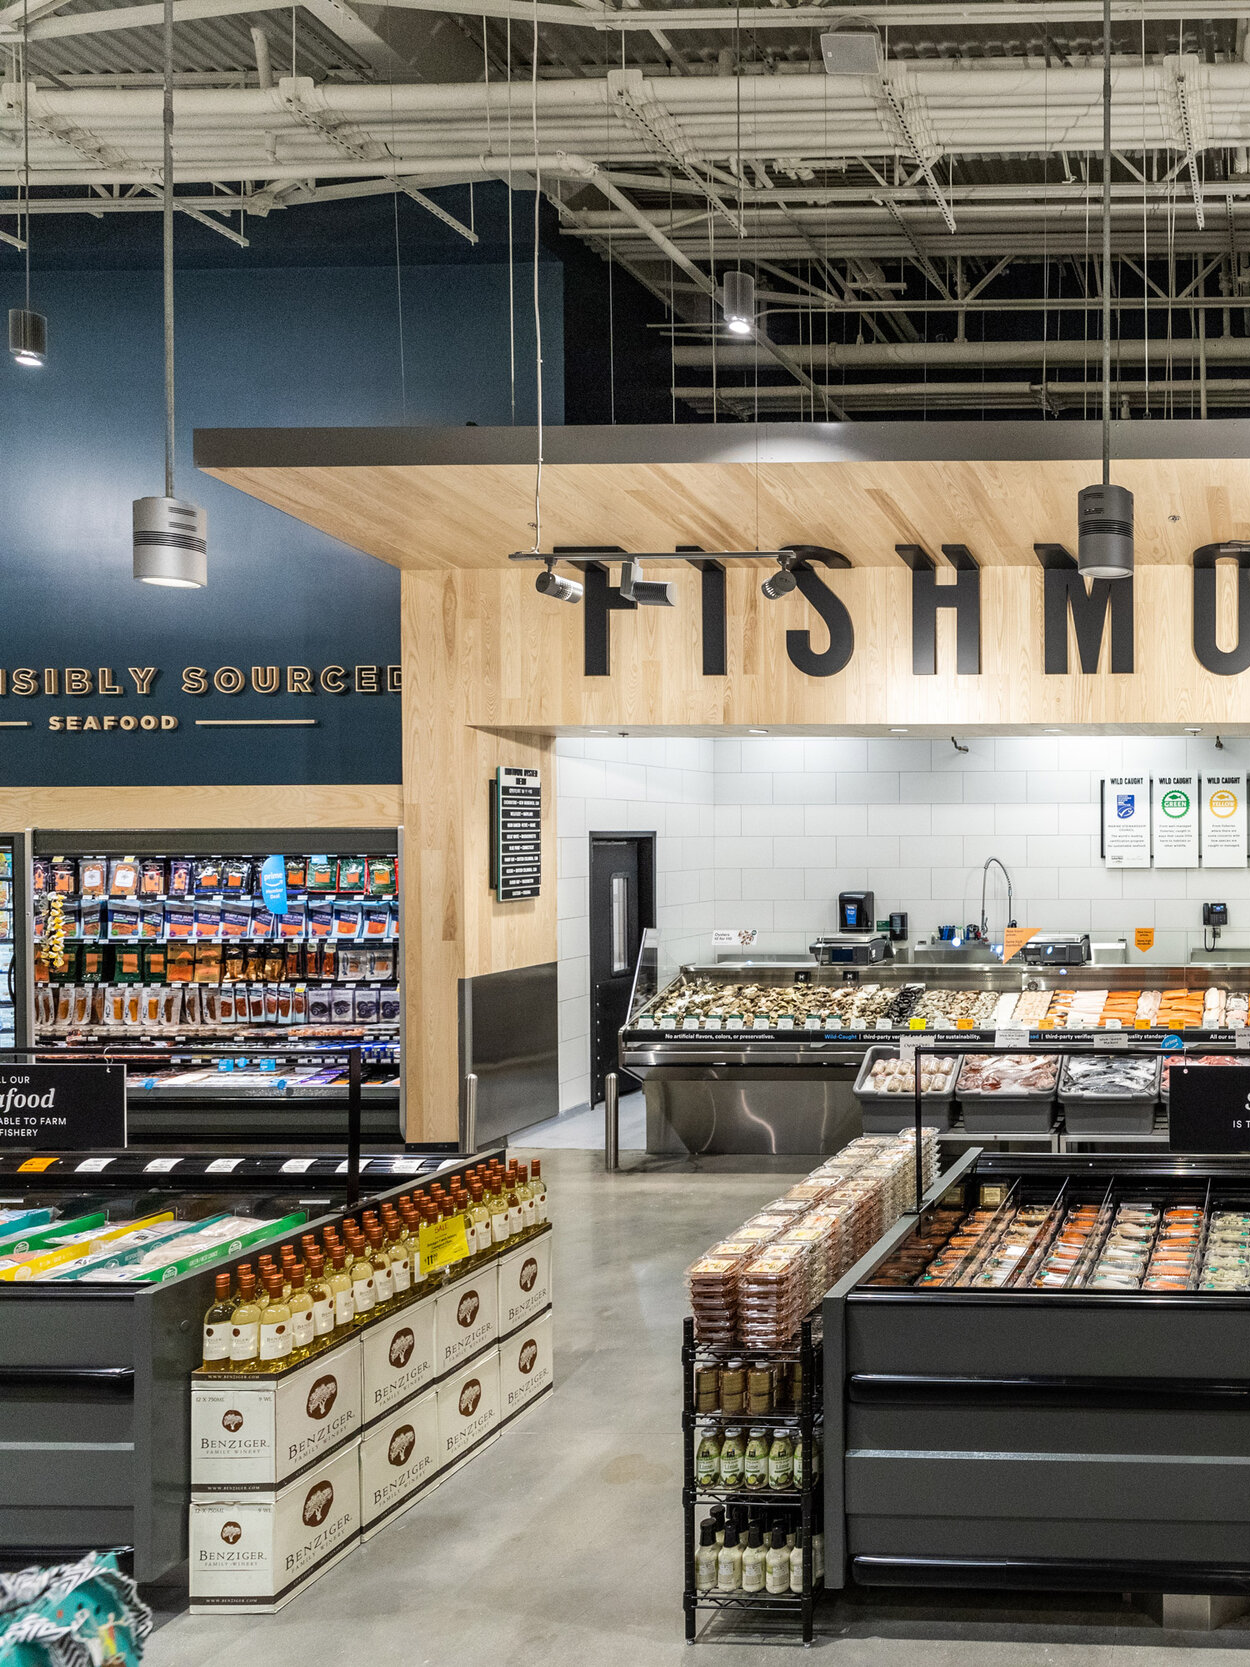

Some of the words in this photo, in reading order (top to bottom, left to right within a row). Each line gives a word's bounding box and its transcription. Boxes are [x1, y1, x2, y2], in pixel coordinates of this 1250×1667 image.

[48, 716, 179, 732] SEAFOOD
[10, 1076, 30, 1084] OUR
[24, 1117, 37, 1125] TO
[40, 1117, 67, 1125] FARM
[1233, 1120, 1242, 1128] IS
[508, 1289, 547, 1320] BENZIGER
[445, 1322, 491, 1359] BENZIGER
[374, 1361, 428, 1404] BENZIGER
[508, 1368, 549, 1404] BENZIGER
[201, 1438, 266, 1449] BENZIGER
[288, 1410, 353, 1460] BENZIGER
[446, 1409, 494, 1451] BENZIGER
[374, 1456, 430, 1505] BENZIGER
[200, 1550, 264, 1560] BENZIGER
[285, 1514, 350, 1571] BENZIGER
